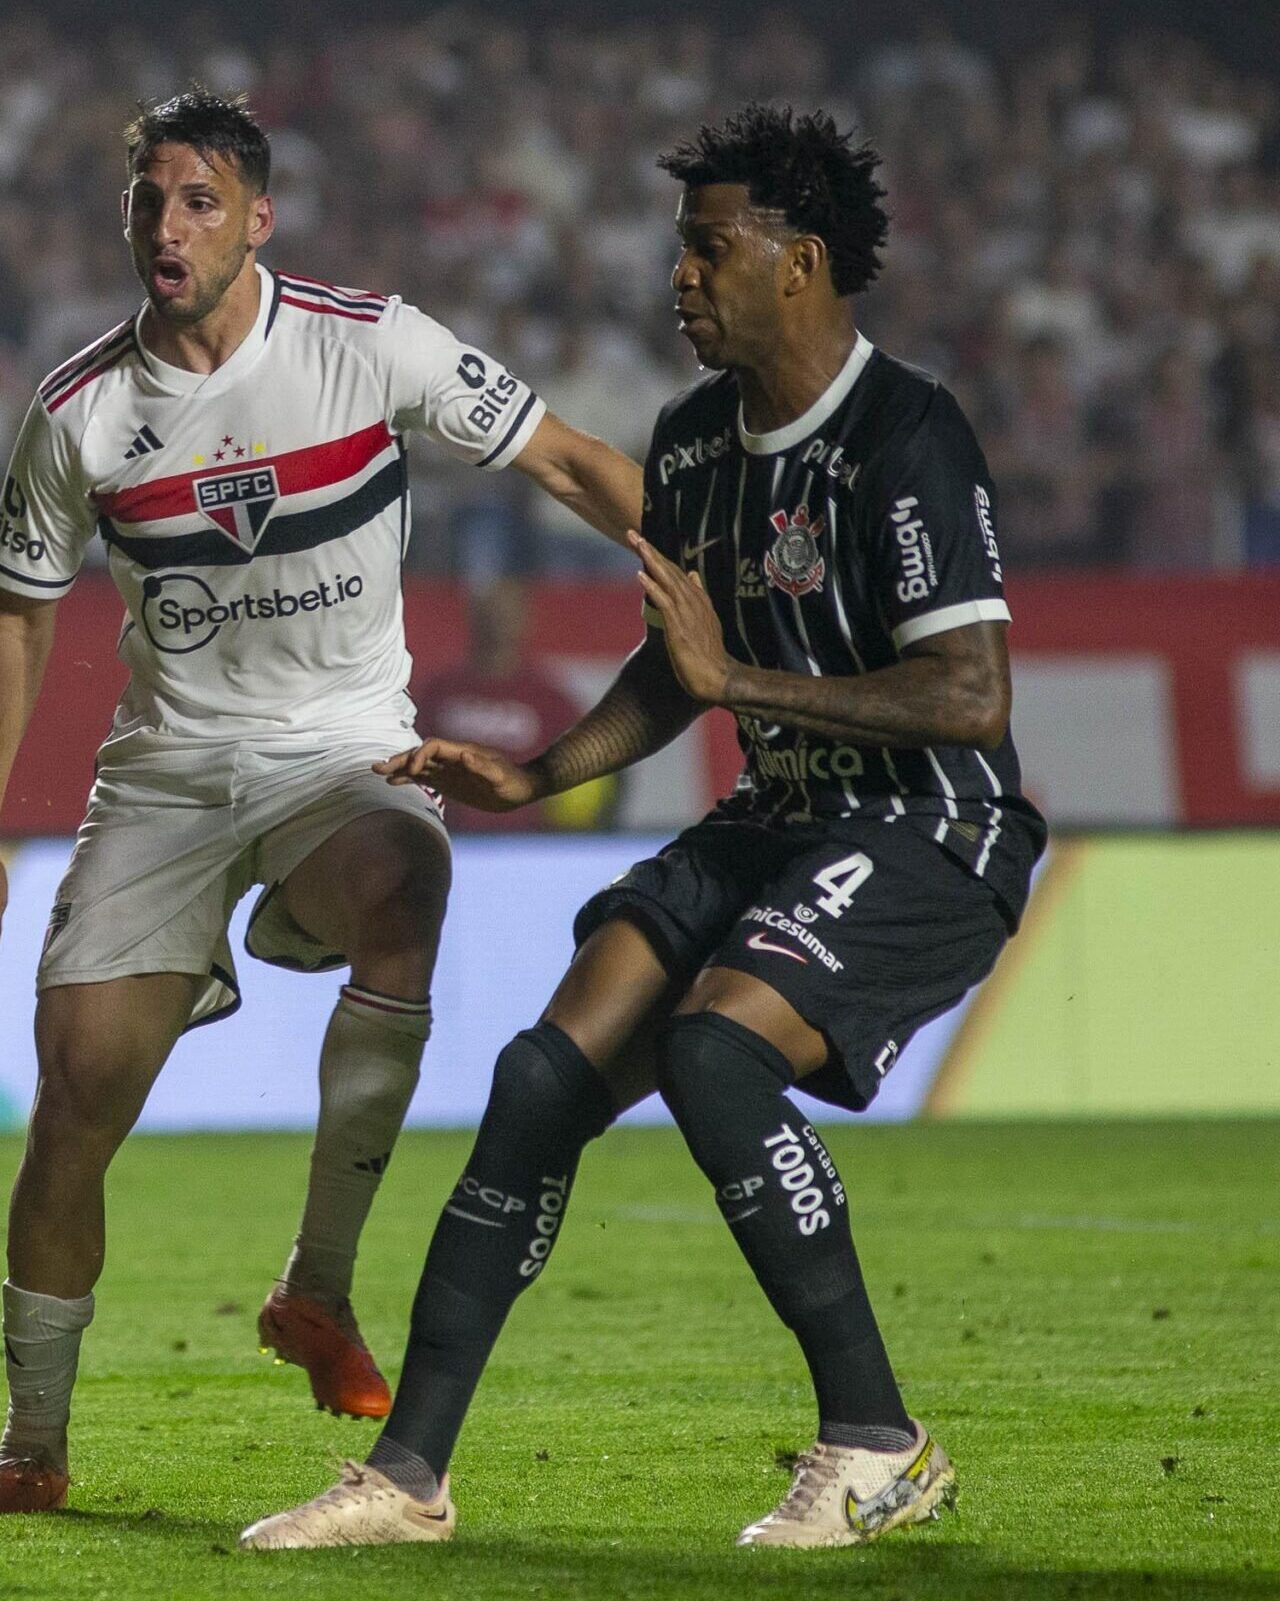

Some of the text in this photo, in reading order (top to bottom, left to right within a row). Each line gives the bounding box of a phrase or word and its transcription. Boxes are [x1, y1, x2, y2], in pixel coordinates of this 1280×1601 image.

[201, 475, 272, 504] SPFC
[895, 519, 930, 602] bmg
[158, 573, 364, 635] Sportsbet.io
[812, 851, 874, 919] 4
[763, 1122, 831, 1236] TODOS
[519, 1174, 569, 1278] TODOS
